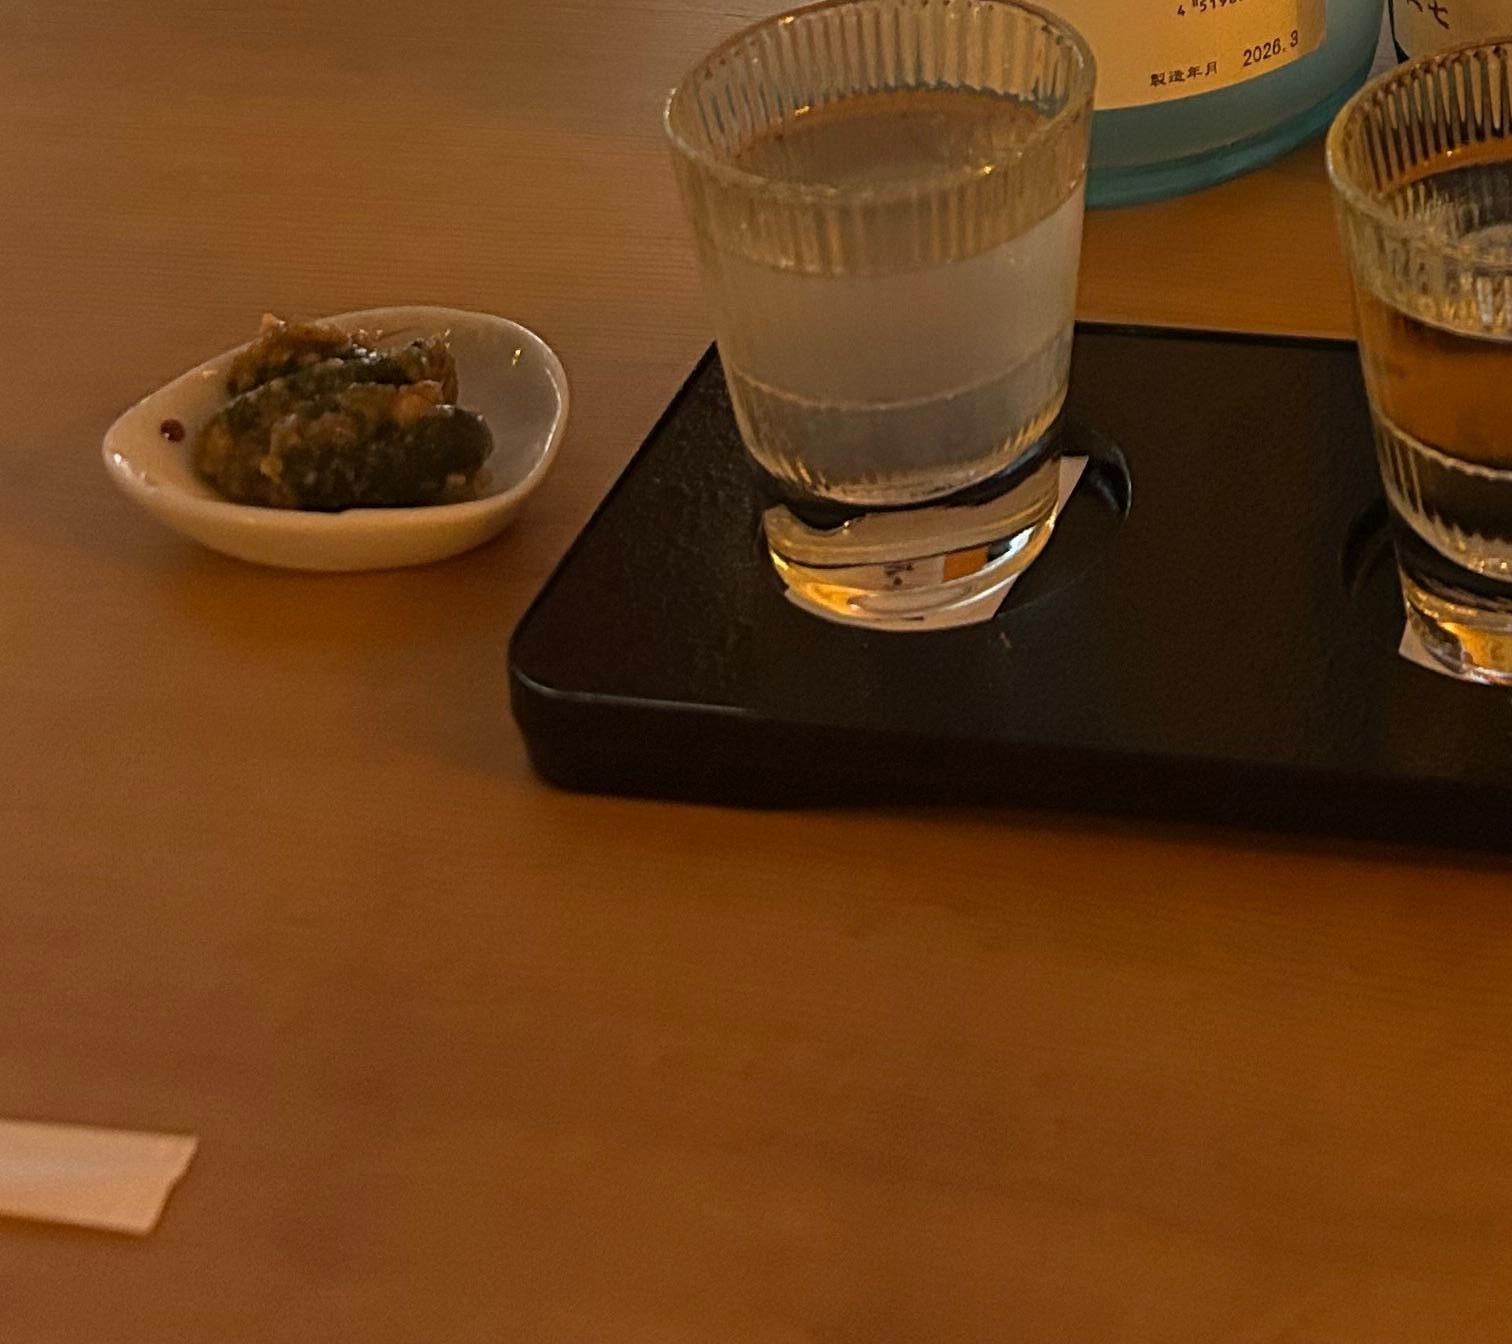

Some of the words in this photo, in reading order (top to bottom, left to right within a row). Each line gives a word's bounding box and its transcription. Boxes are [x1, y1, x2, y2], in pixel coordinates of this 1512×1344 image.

[1176, 4, 1186, 16] 4
[1150, 60, 1218, 87] 製造年月
